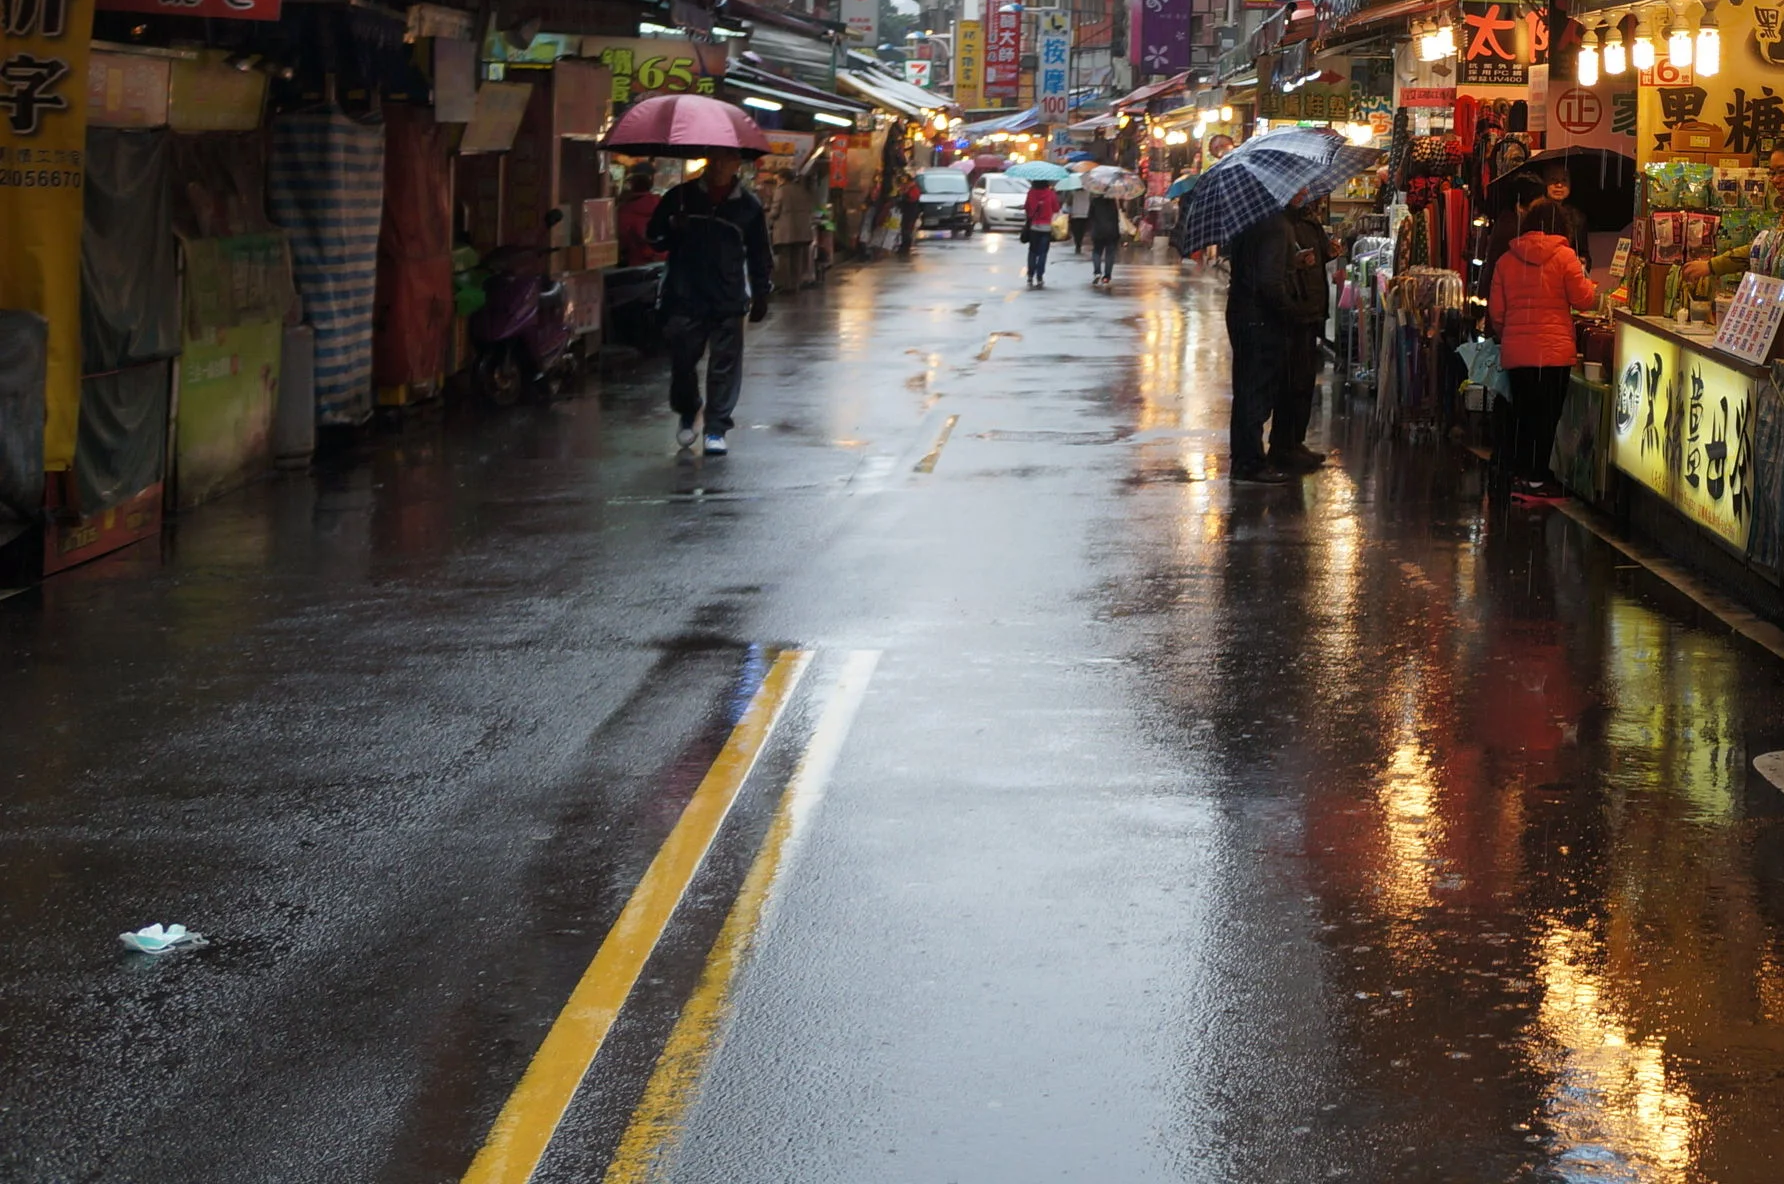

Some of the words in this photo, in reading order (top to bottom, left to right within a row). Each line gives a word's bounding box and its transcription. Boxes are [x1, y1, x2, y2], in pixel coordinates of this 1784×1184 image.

[1043, 38, 1067, 94] 按摩
[1657, 57, 1680, 83] 6
[1042, 97, 1067, 114] 100
